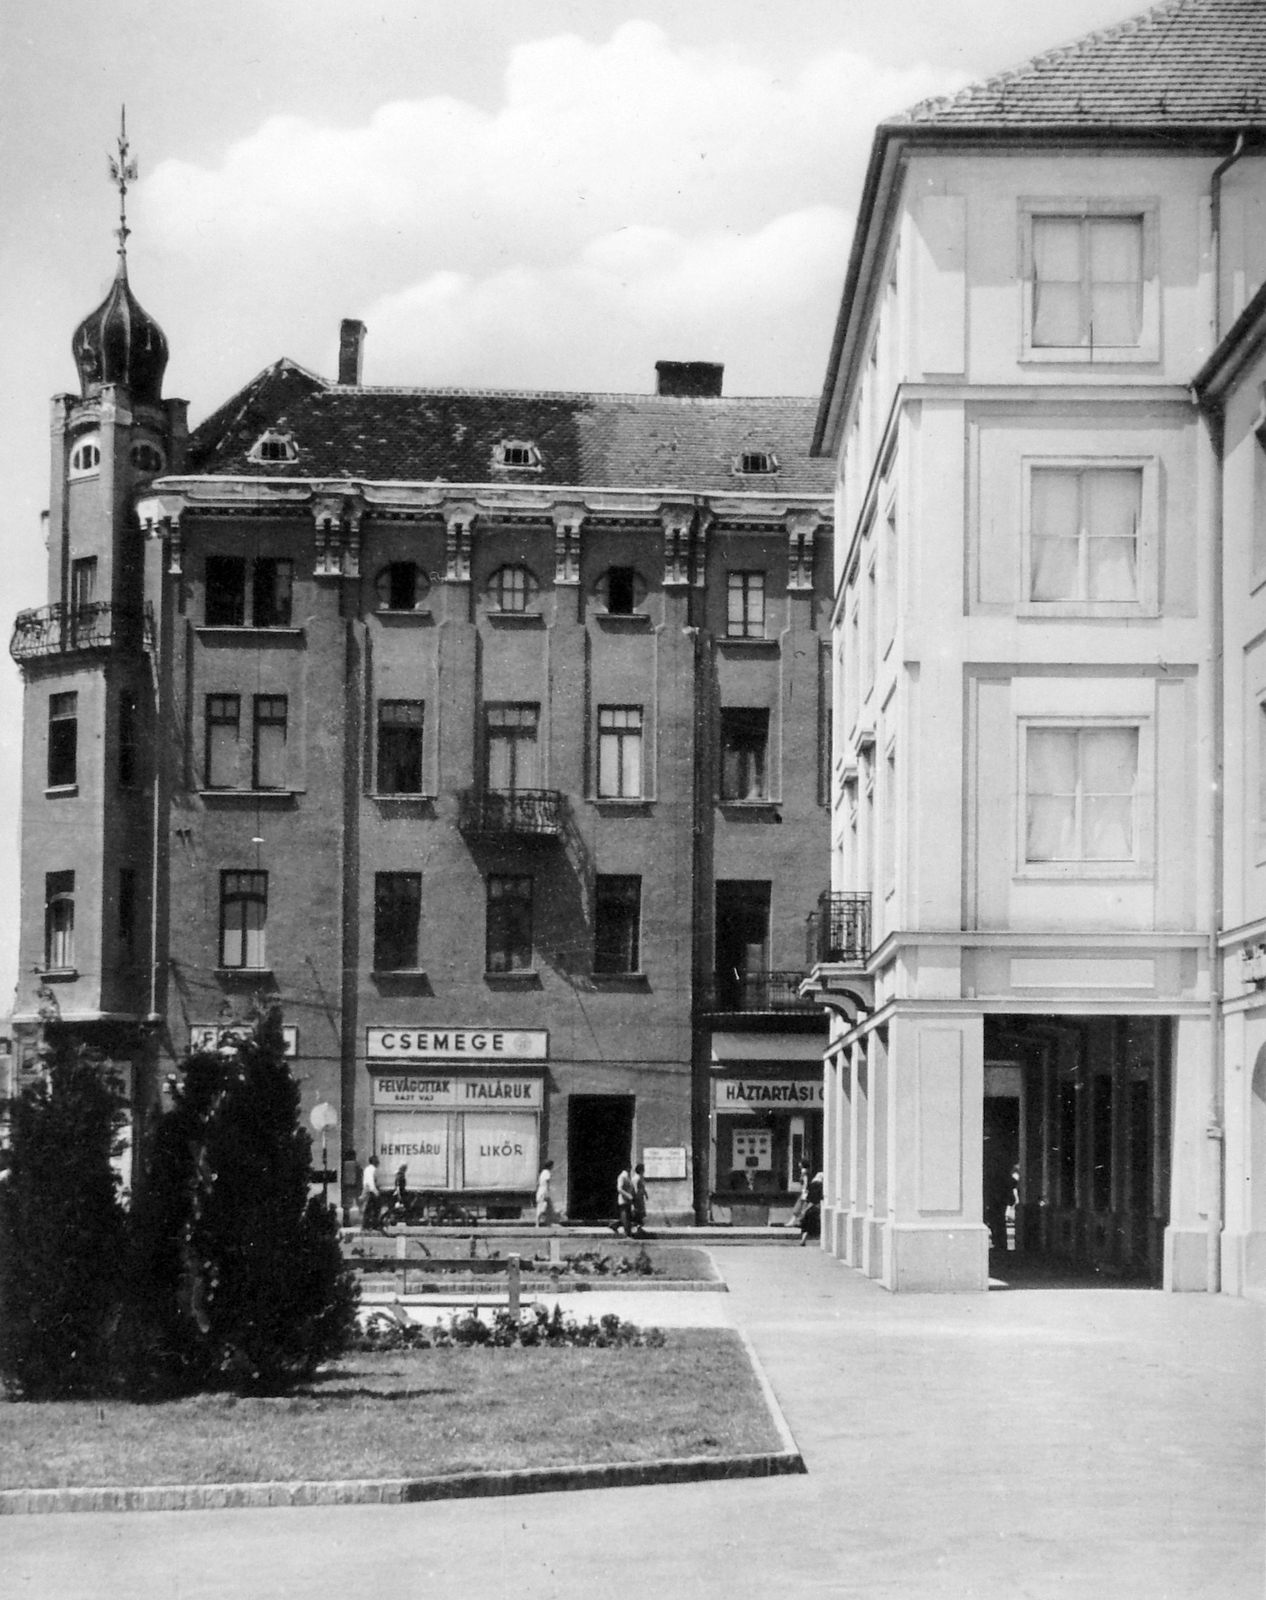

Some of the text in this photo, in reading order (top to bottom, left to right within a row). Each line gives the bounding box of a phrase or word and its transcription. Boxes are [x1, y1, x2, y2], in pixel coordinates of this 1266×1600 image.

[381, 1033, 504, 1051] CSEMEGE
[378, 1077, 450, 1093] FELVÁGOTTAK
[465, 1080, 532, 1099] ITALÁRUK
[726, 1081, 814, 1101] HÁZTARTÁSI
[380, 1140, 441, 1156] HENTESÁRU
